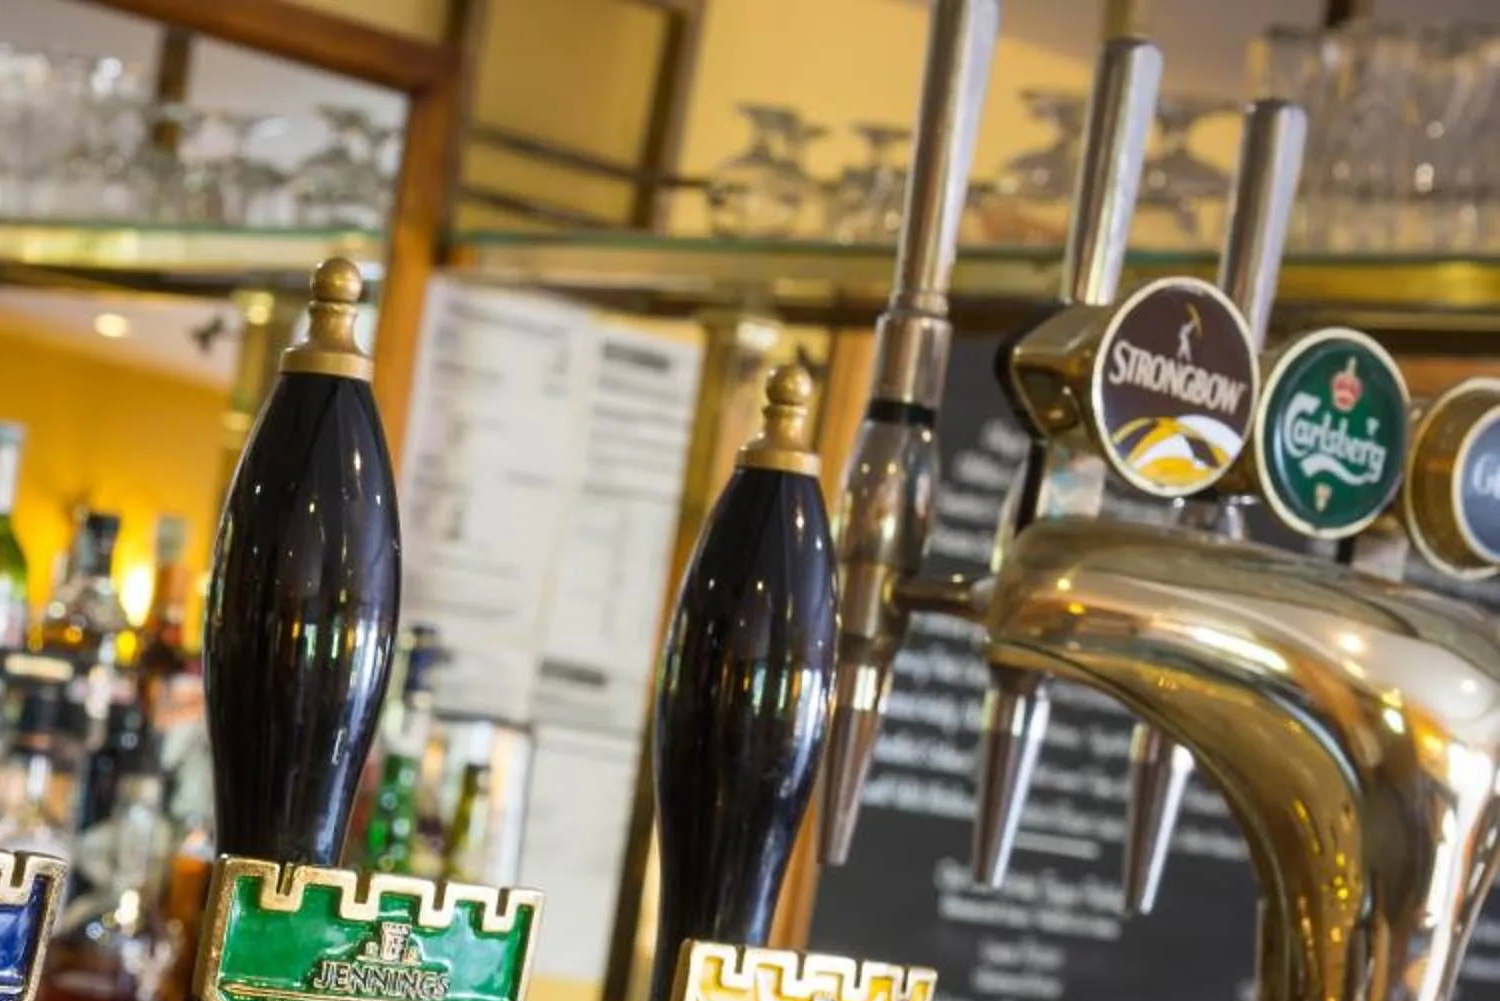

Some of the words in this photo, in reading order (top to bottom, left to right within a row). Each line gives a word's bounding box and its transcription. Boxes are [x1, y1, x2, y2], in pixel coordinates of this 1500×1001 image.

[1108, 339, 1248, 416] STRONGBOW
[1283, 391, 1387, 485] Carlsberg
[313, 960, 450, 1001] JENNINGS
